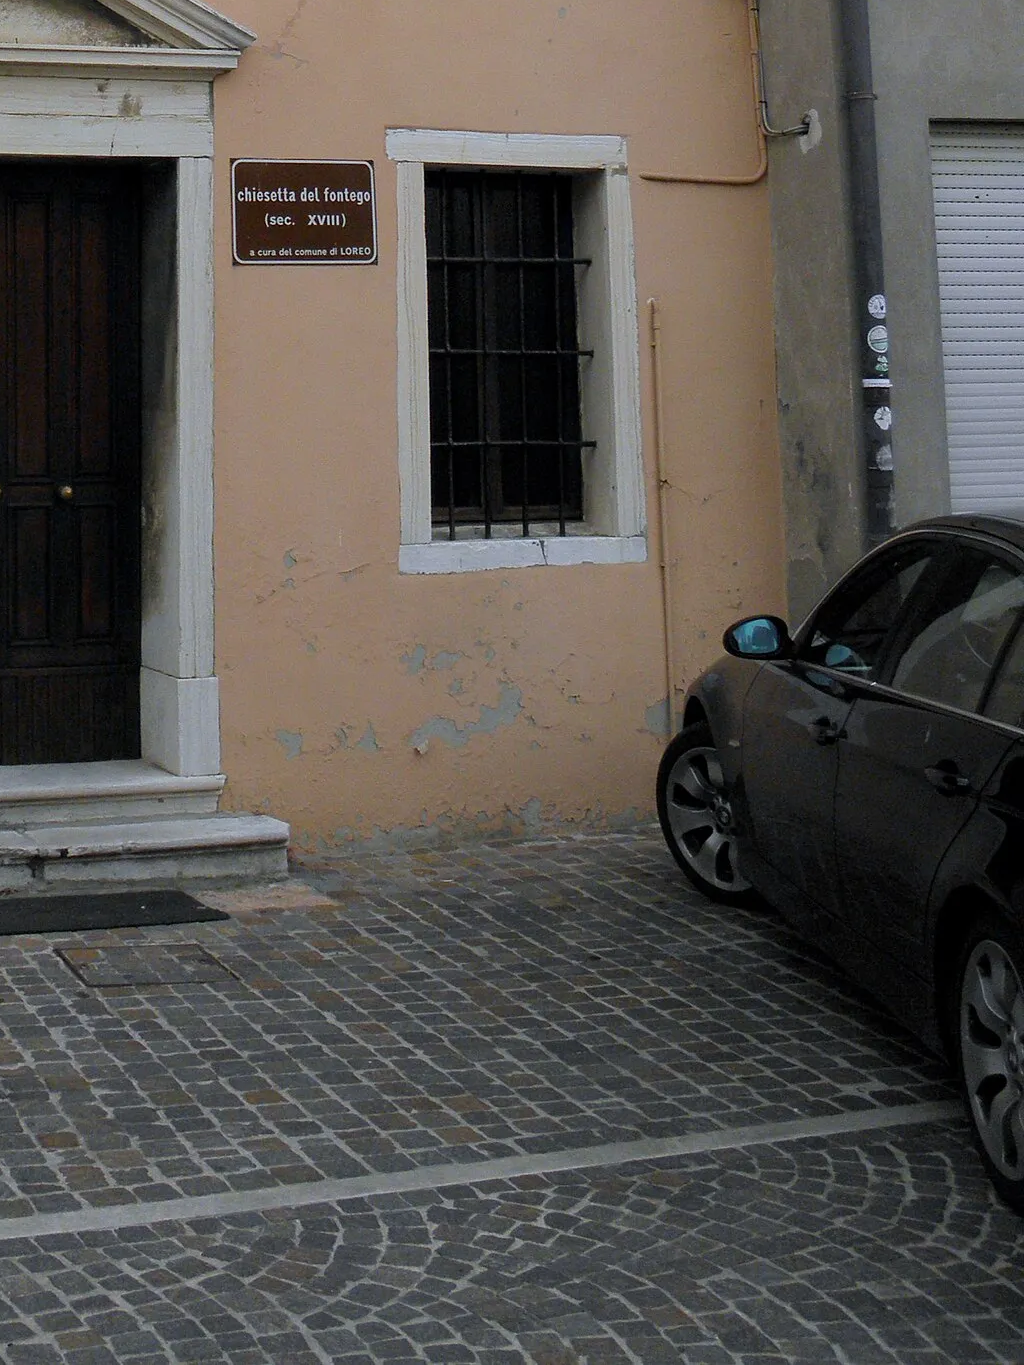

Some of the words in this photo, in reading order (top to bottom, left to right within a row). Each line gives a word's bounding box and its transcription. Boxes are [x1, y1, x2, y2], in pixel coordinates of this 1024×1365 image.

[237, 187, 296, 202] chiesetta
[300, 187, 320, 202] del
[324, 187, 371, 205] fontego
[264, 213, 295, 227] (sec.
[307, 213, 346, 227] XVIII)
[279, 248, 292, 256] del
[294, 248, 327, 256] comune
[329, 247, 338, 255] di
[340, 247, 371, 256] LOREO
